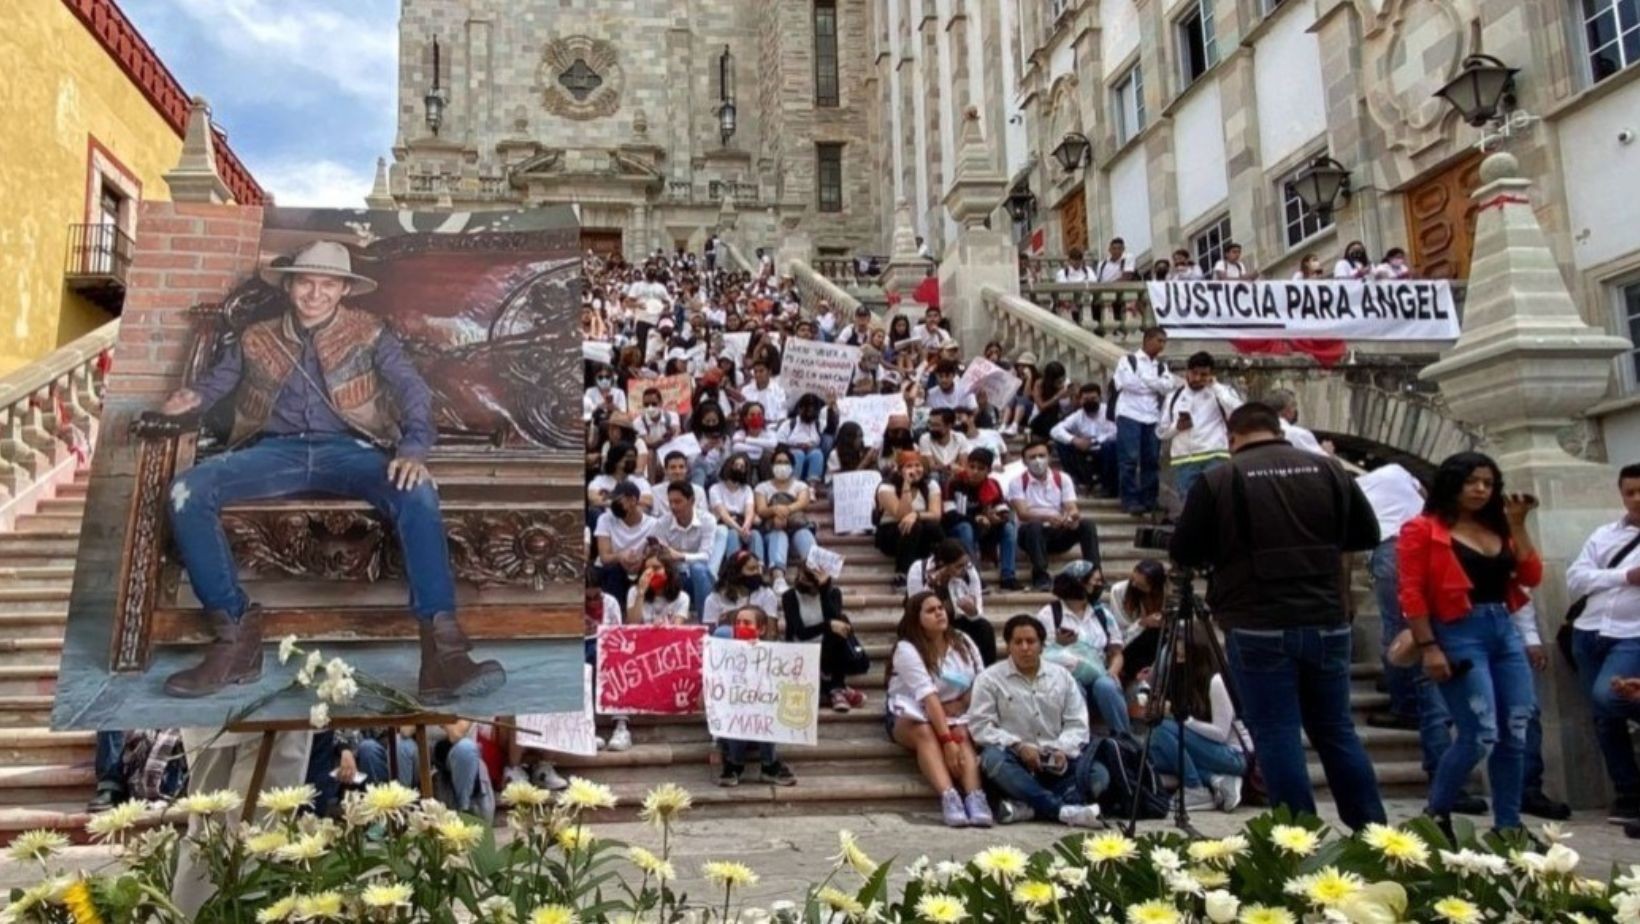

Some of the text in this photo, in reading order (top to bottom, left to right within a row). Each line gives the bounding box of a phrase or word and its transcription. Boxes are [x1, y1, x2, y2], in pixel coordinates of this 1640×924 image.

[1156, 282, 1280, 318] JUSTICIA
[1286, 284, 1356, 319] PARA
[1247, 466, 1319, 477] MULTIMEDIOS
[604, 637, 701, 701] JUSTICIA
[728, 714, 773, 735] MATAR
